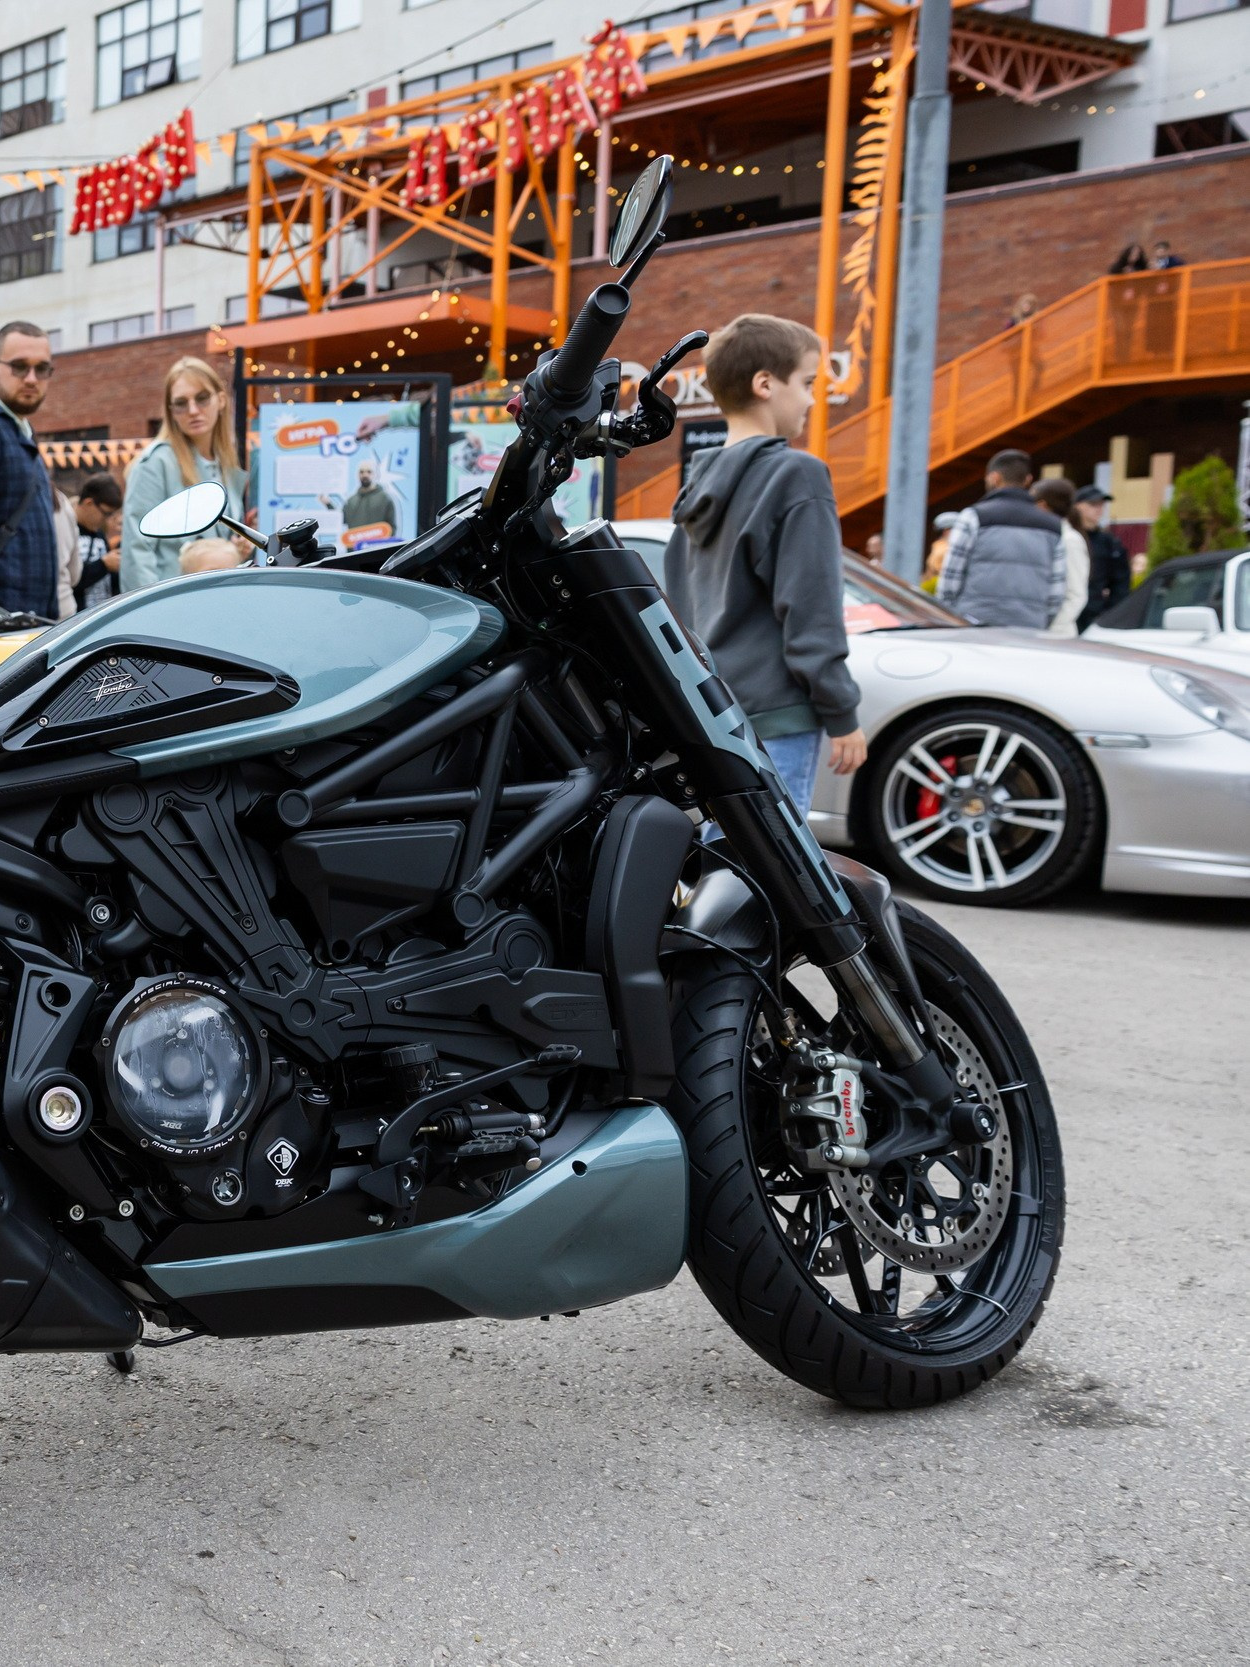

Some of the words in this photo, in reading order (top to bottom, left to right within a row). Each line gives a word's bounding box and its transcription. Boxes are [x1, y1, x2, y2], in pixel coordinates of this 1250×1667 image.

[134, 980, 181, 1004] SPECIAL
[187, 979, 227, 995] PARTS
[840, 1080, 855, 1137] brembo
[152, 1140, 184, 1154] MADE
[203, 1135, 235, 1153] ITALY
[275, 1178, 294, 1186] DBK
